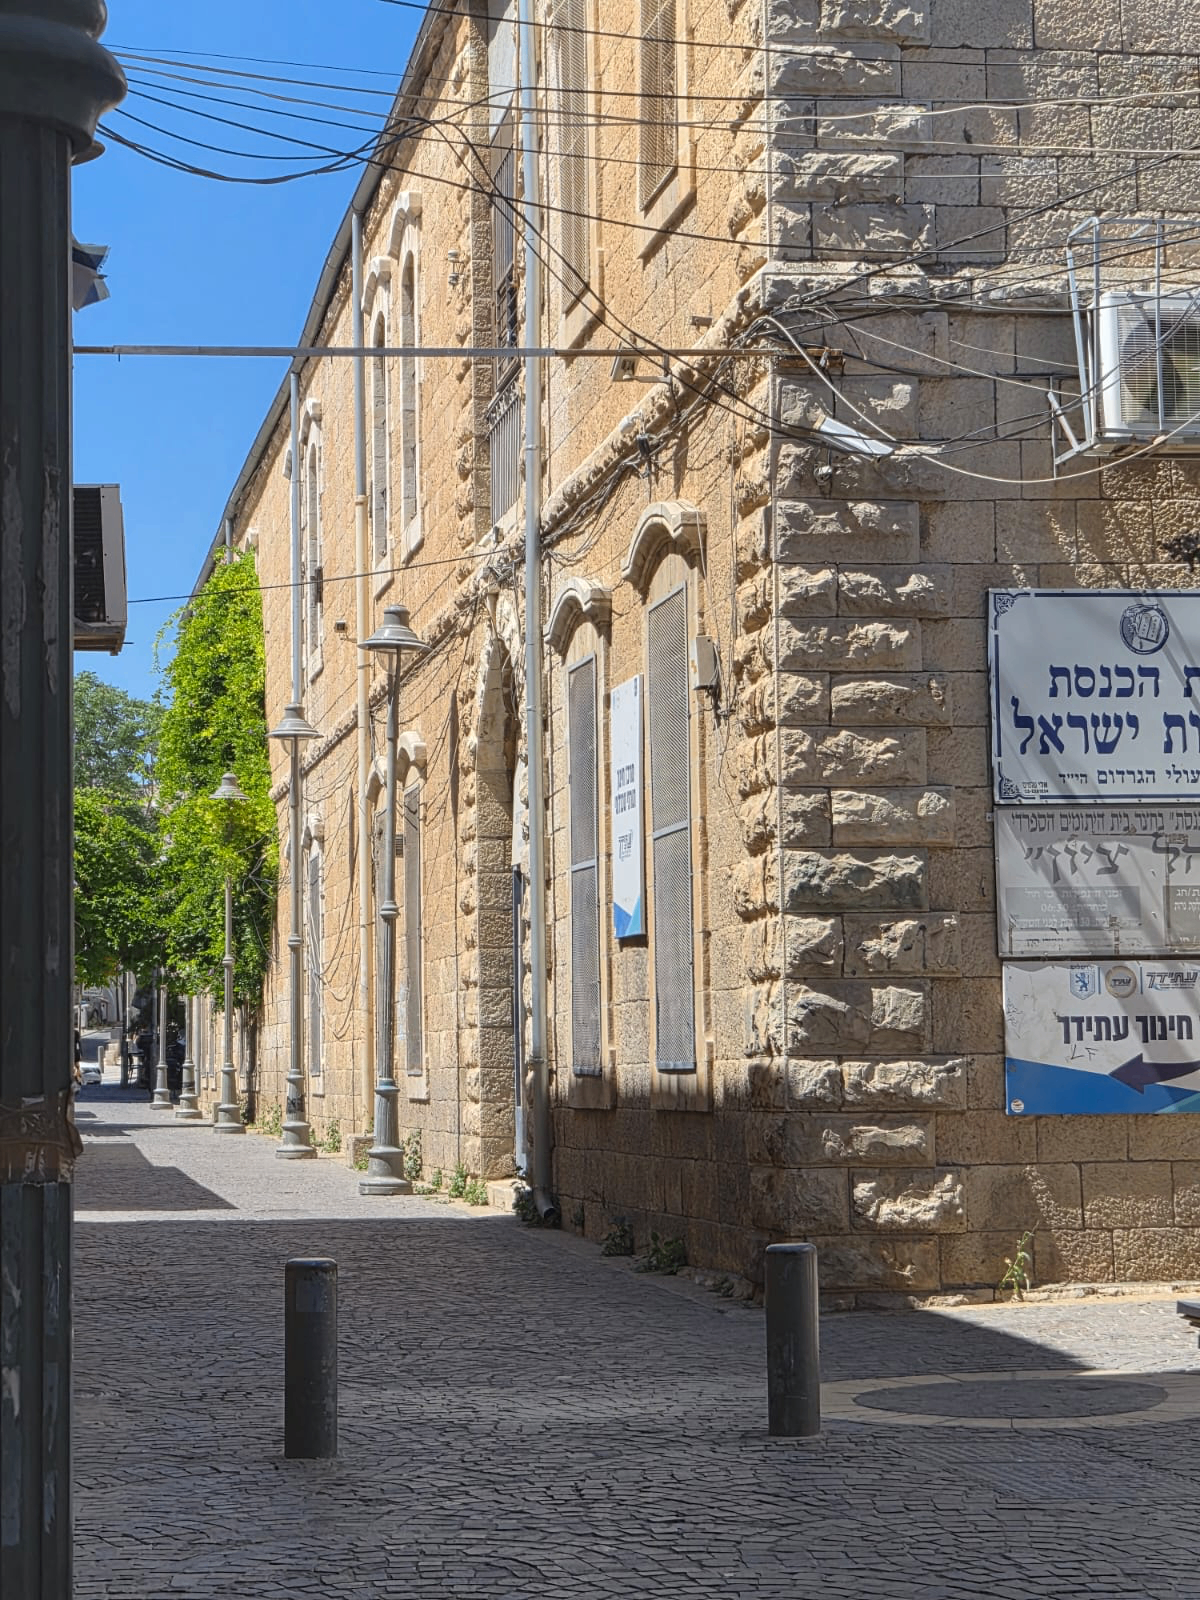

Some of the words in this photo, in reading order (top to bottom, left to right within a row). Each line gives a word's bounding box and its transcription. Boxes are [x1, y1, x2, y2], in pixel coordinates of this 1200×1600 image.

[1049, 664, 1160, 698] הכנסת
[1011, 696, 1139, 755] ישראל
[1097, 769, 1156, 784] הגרדום
[1011, 811, 1055, 832] הספרדי
[1059, 811, 1105, 832] היתומים
[1110, 811, 1130, 831] בית
[1146, 971, 1198, 989] עתידך
[1057, 1015, 1129, 1045] עתידך
[1135, 1015, 1193, 1043] חינוך
